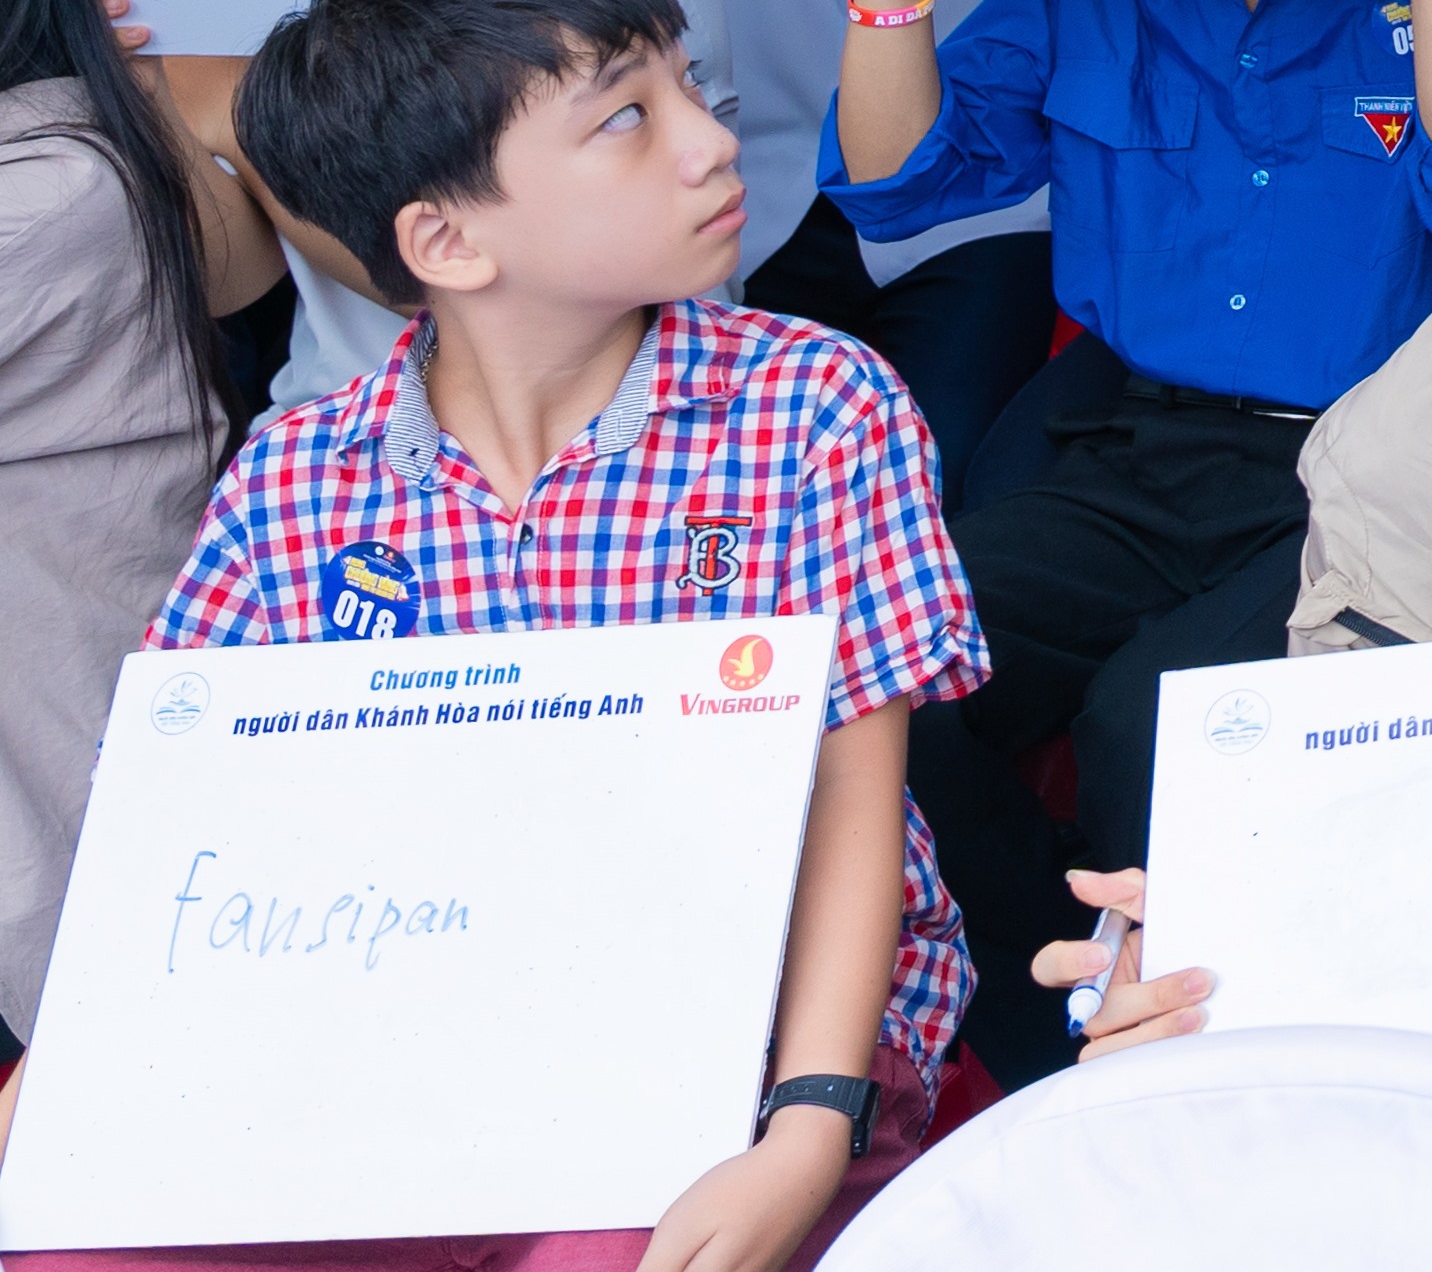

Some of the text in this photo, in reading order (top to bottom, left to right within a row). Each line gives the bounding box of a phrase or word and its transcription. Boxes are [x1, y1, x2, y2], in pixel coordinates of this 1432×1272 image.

[333, 590, 397, 639] 018
[369, 662, 521, 691] Chương trình
[232, 692, 643, 737] người dân Khánh Hòa nói tiếng Anh
[679, 689, 800, 715] VINGROUP
